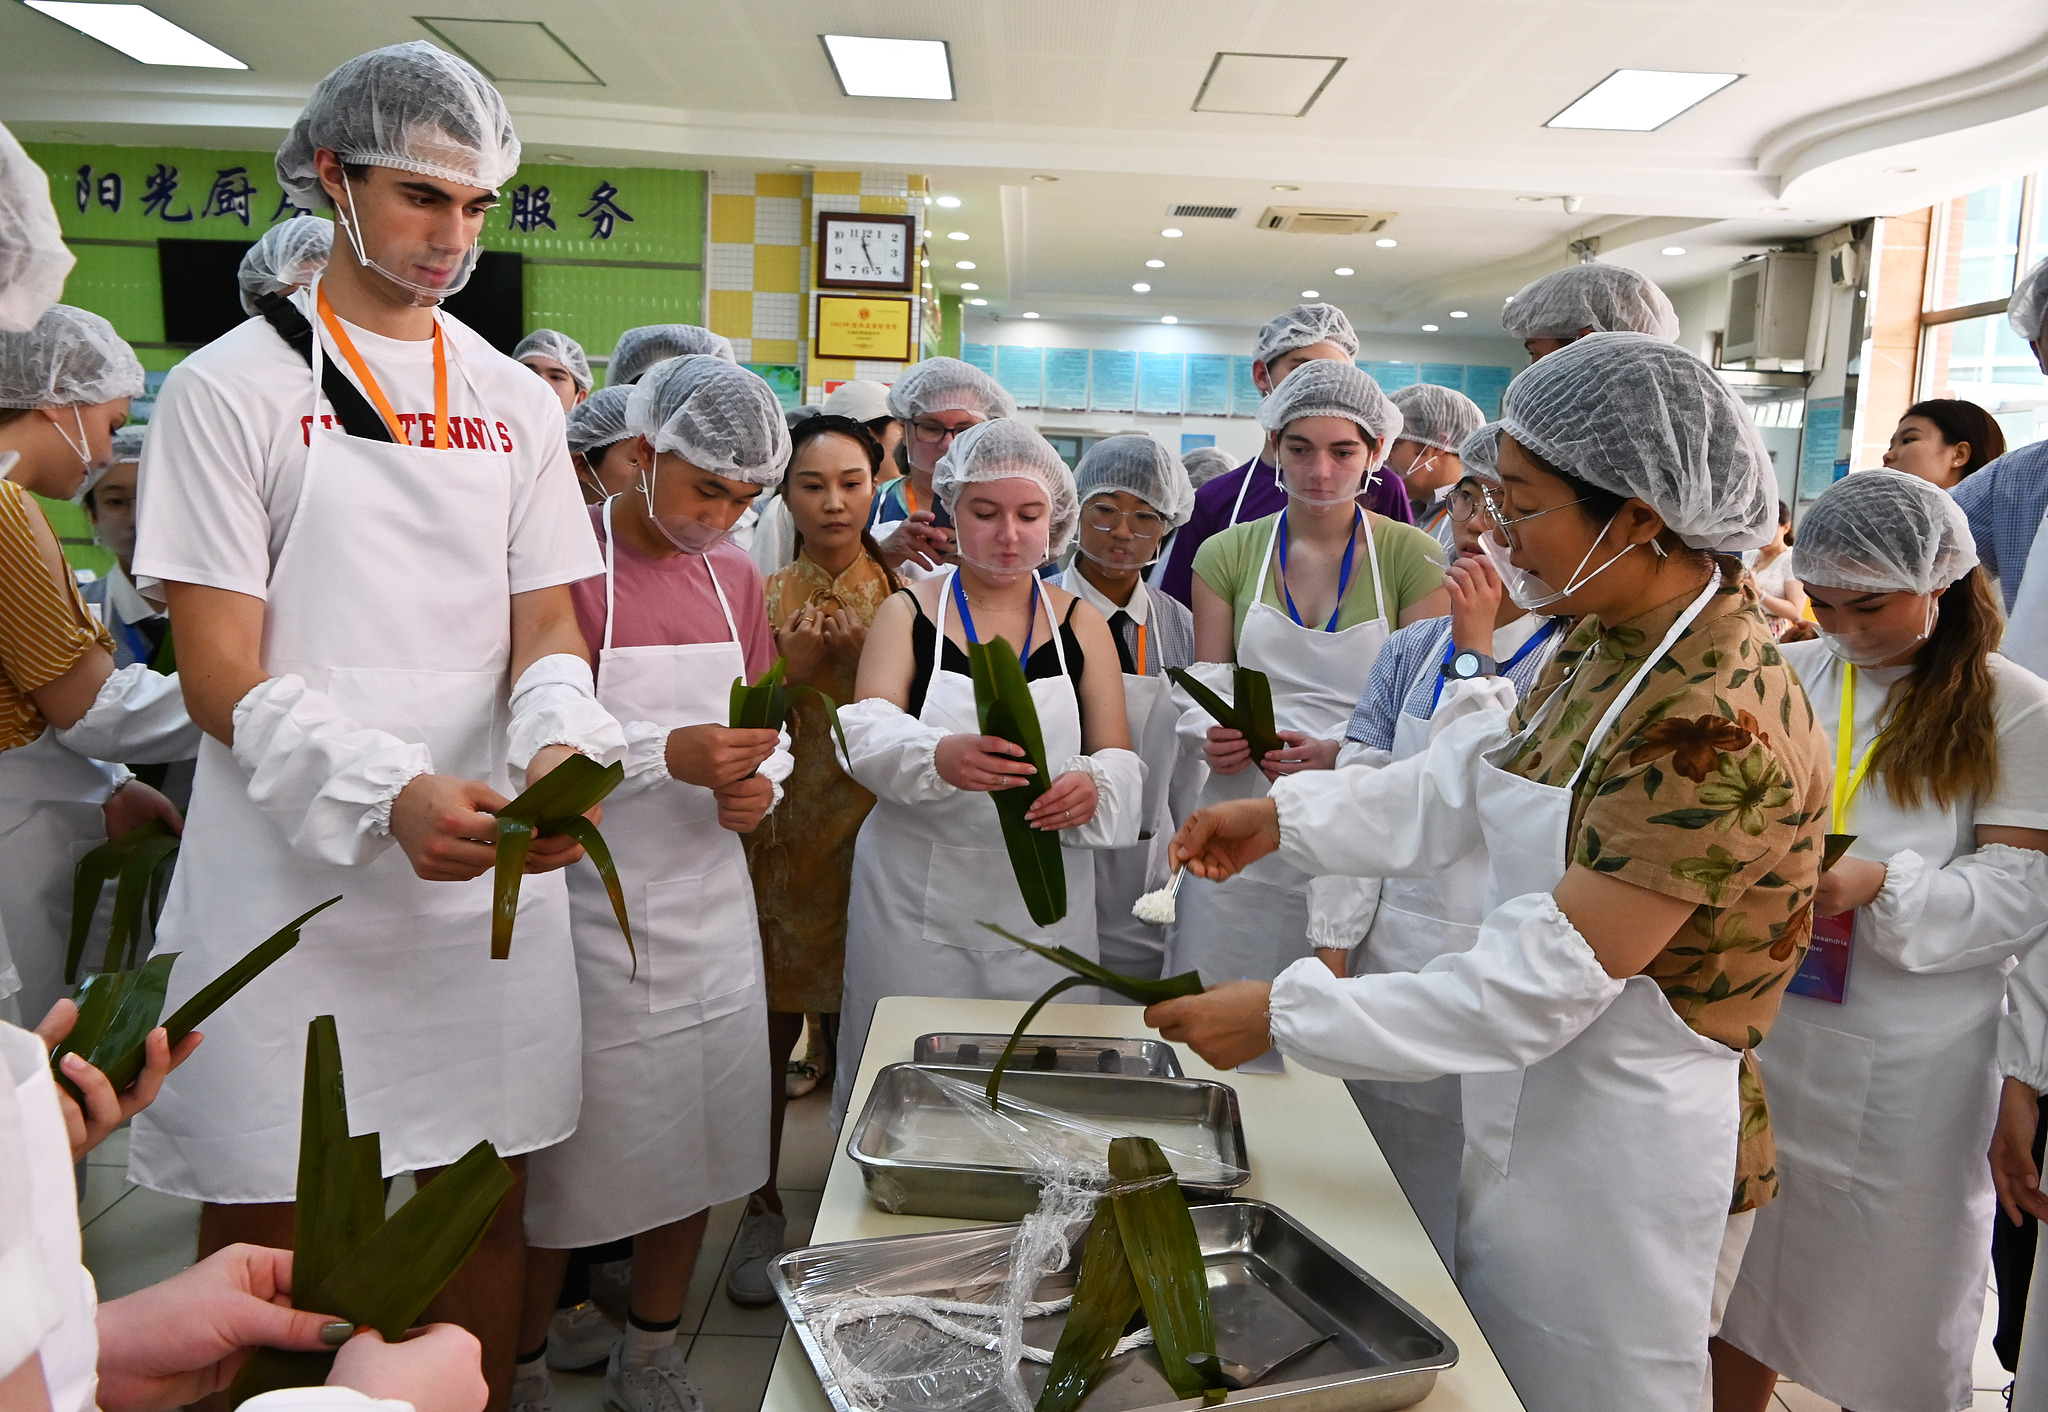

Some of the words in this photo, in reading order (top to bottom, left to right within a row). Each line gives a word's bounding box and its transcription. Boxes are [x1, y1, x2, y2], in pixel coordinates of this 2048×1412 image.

[508, 181, 634, 240] 服务
[834, 231, 844, 239] 10
[850, 229, 859, 238] 11
[862, 229, 872, 238] 12
[891, 233, 898, 242] 2
[834, 246, 842, 255] 9
[890, 249, 898, 257] 3
[834, 263, 842, 271] 8
[850, 265, 857, 274] 7
[861, 266, 869, 274] 6
[874, 266, 882, 275] 5
